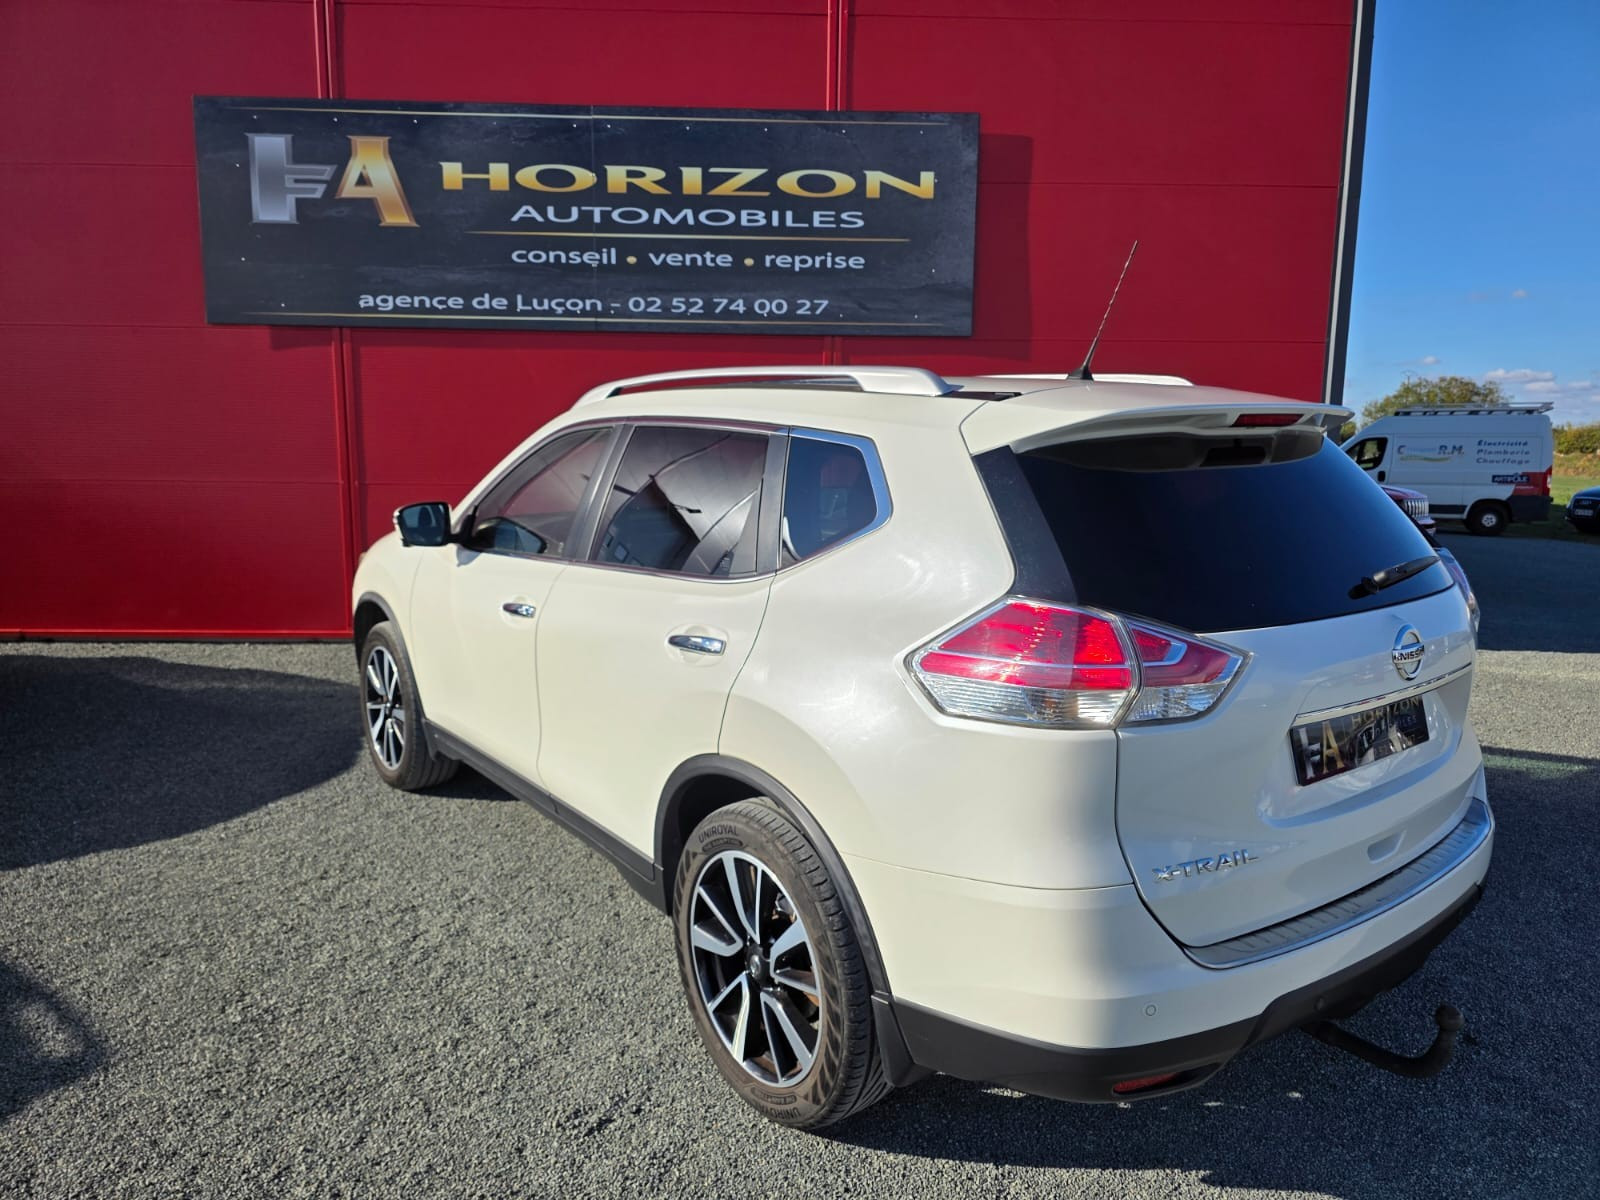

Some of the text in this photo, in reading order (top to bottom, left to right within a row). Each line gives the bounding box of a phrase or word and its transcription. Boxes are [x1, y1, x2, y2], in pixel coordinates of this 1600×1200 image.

[438, 161, 936, 199] HORIZON
[510, 205, 865, 229] AUTOMOBILES
[511, 247, 866, 272] conseil vente reprise
[359, 294, 464, 311] agence
[471, 292, 508, 310] de
[517, 293, 601, 314] Luçon
[628, 297, 662, 313] 02
[670, 298, 704, 314] 52
[712, 298, 747, 314] 74
[754, 299, 788, 315] 00
[795, 299, 829, 315] 27
[698, 824, 739, 843] UNIROYAL
[1152, 849, 1259, 881] X-TRAIL
